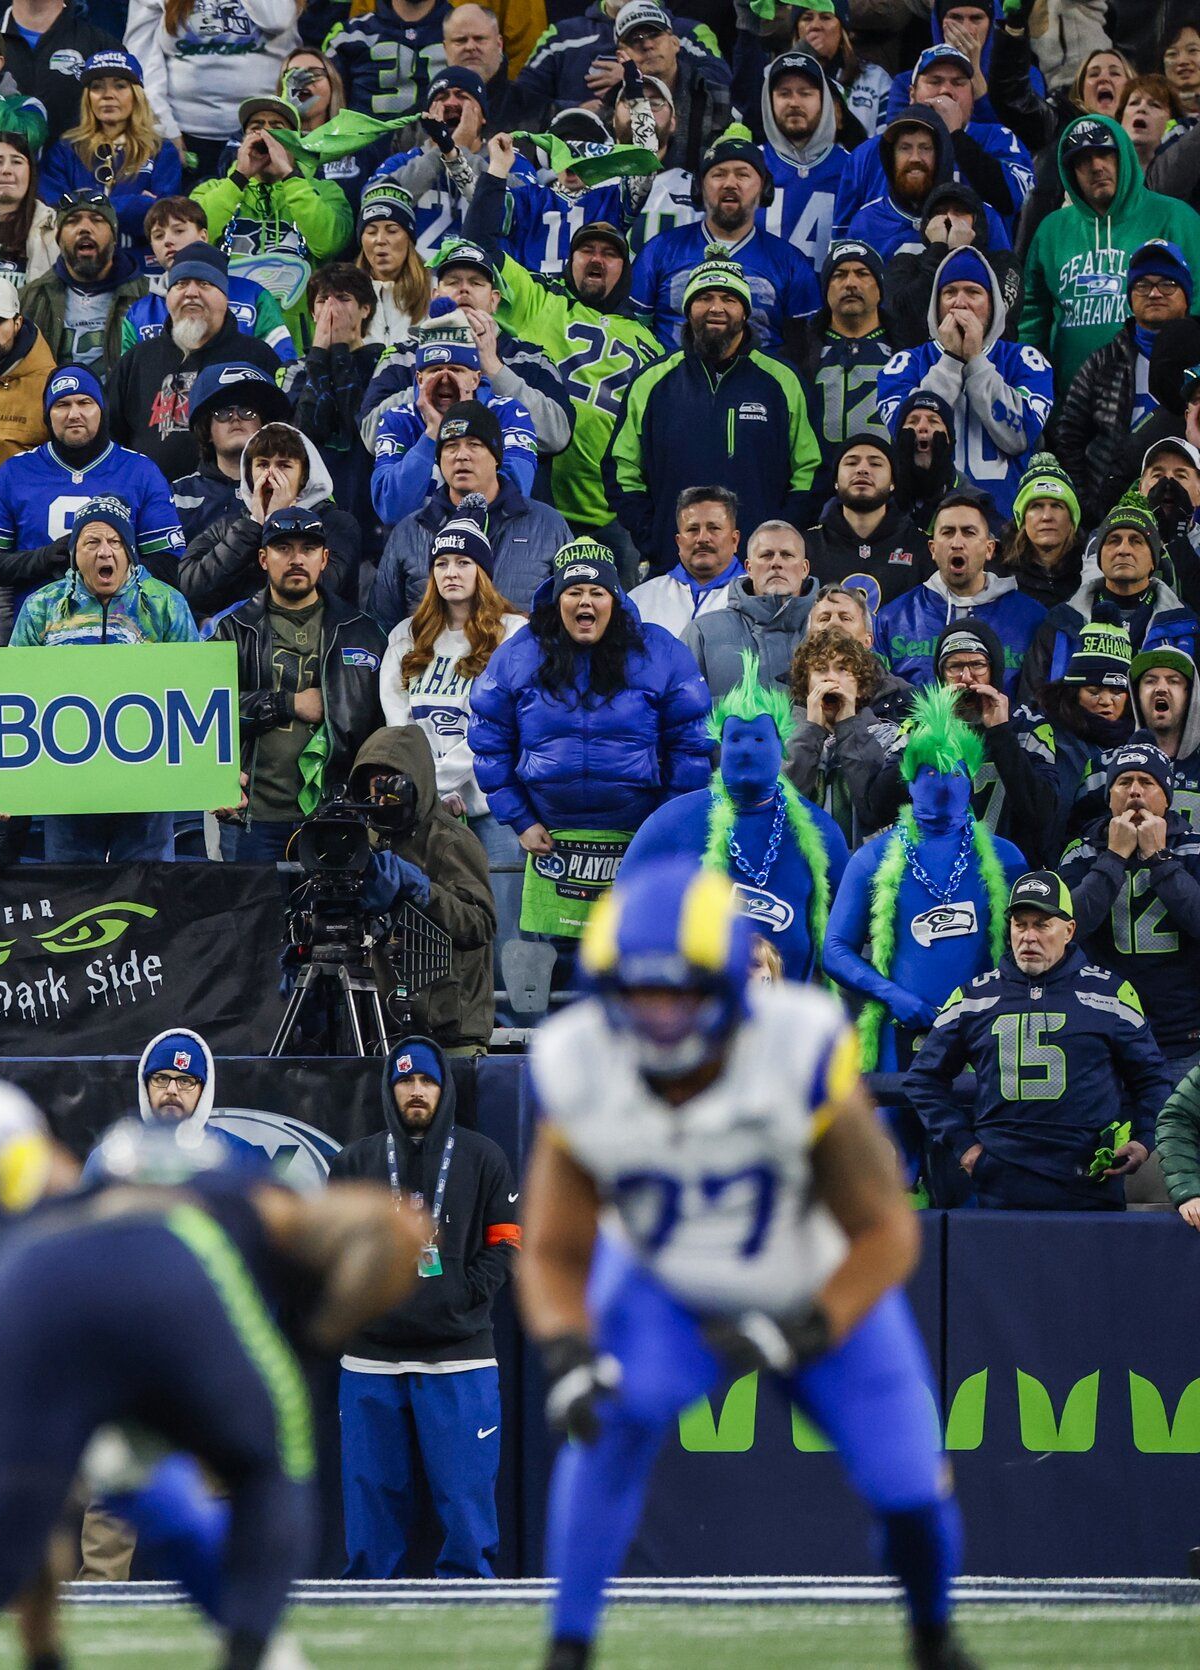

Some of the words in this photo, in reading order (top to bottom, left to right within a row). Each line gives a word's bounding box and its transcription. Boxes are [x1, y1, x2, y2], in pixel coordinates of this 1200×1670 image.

[765, 187, 835, 273] 14
[1059, 248, 1132, 294] SEATTL
[557, 320, 643, 419] 22
[815, 364, 892, 445] 12
[554, 545, 615, 569] SEAHAWKS
[560, 840, 623, 851] SEAHAWKS
[1112, 868, 1179, 954] 12
[86, 949, 162, 1007] Side
[991, 1012, 1066, 1101] 15
